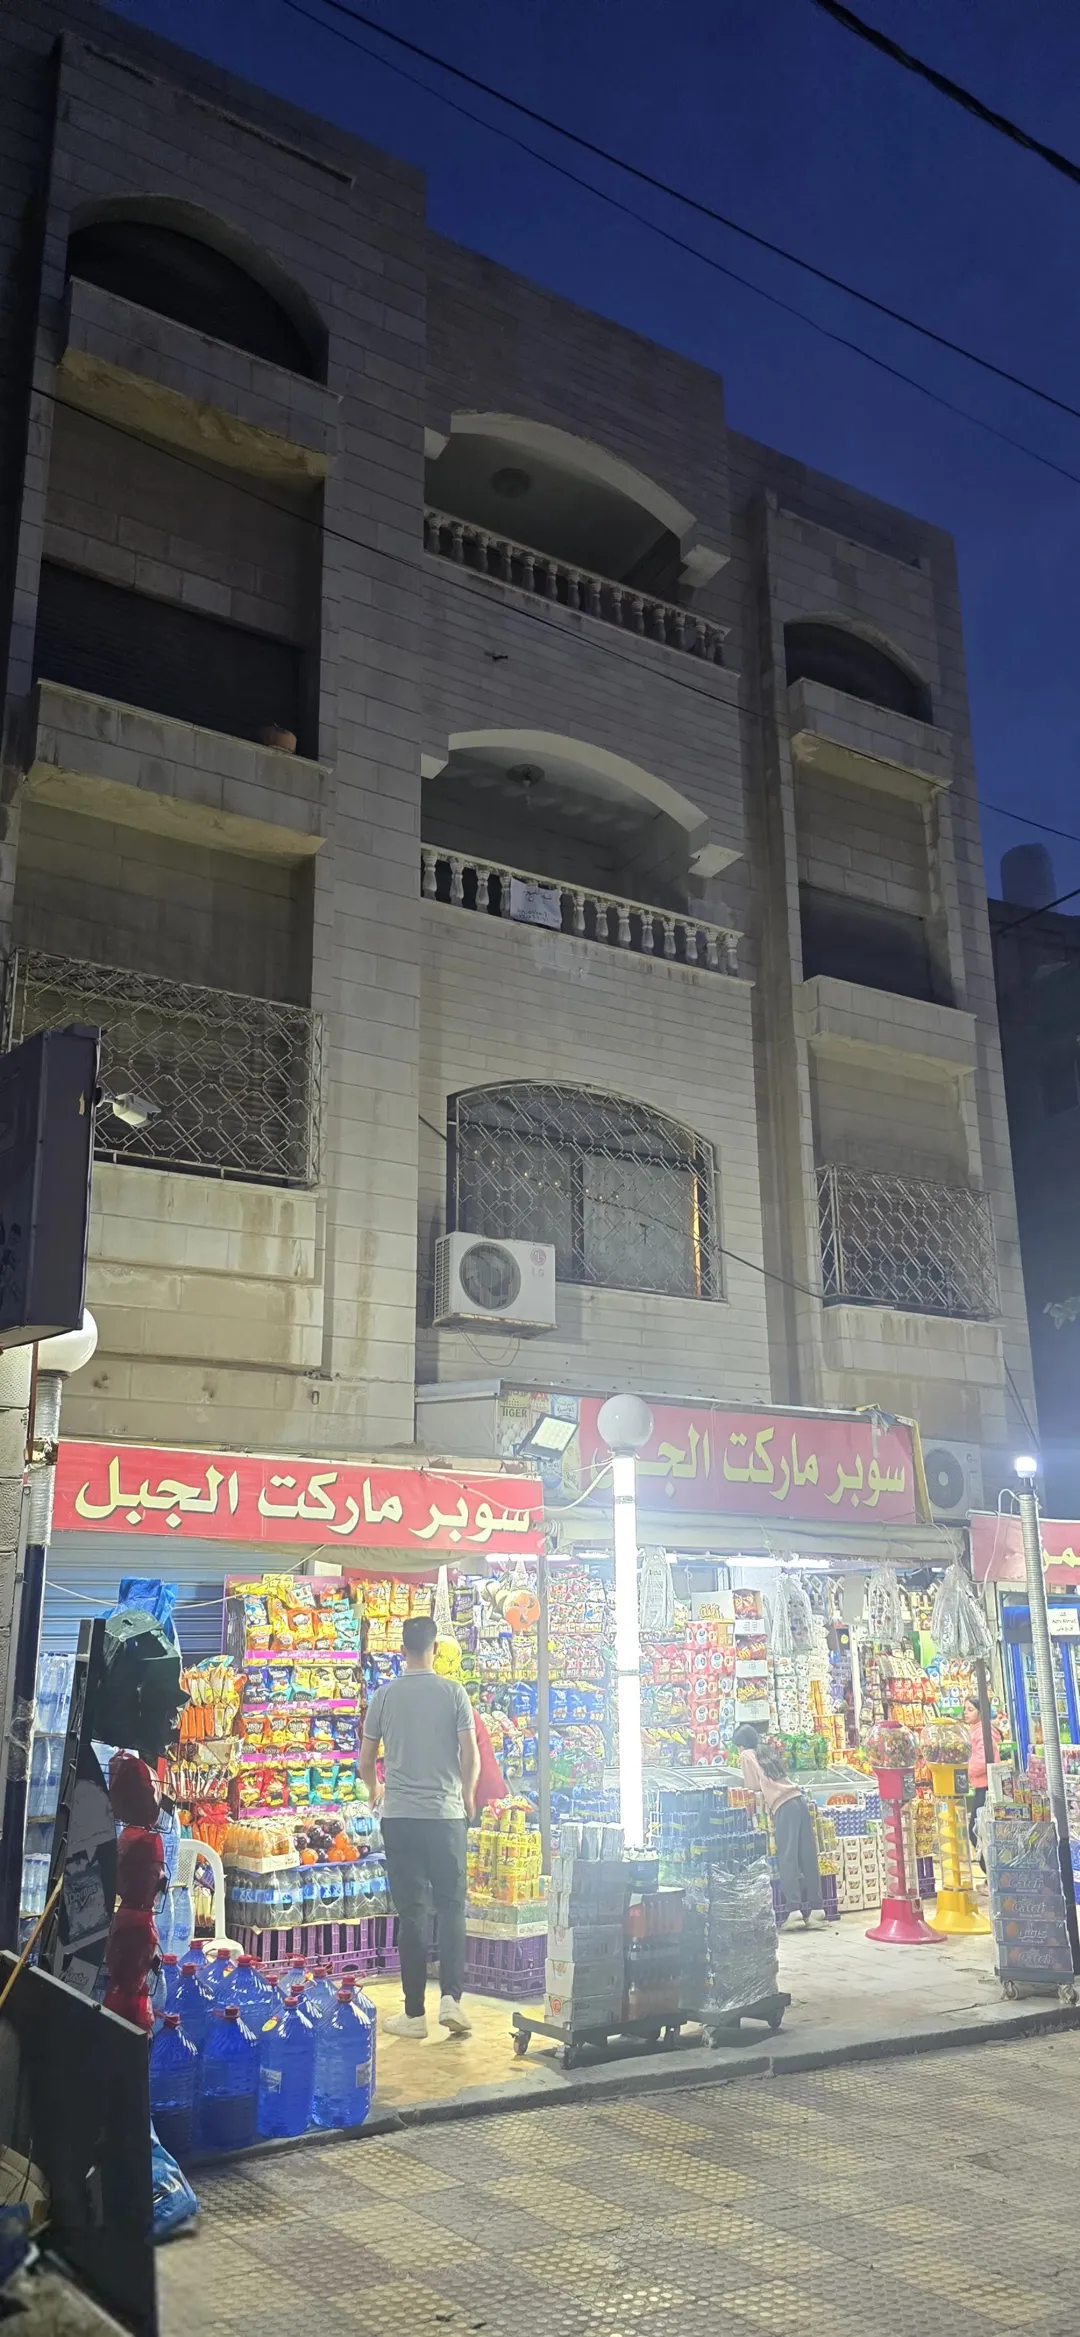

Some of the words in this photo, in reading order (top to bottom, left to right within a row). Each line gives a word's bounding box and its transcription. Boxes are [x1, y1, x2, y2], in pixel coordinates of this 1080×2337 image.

[501, 1406, 528, 1418] TIGER
[723, 1426, 819, 1501] ماركت
[824, 1454, 905, 1508] سوبر
[75, 1456, 240, 1529] الجبل
[257, 1472, 404, 1536] ماركت
[408, 1496, 531, 1544] سوبر
[68, 1884, 99, 1903] Doritos
